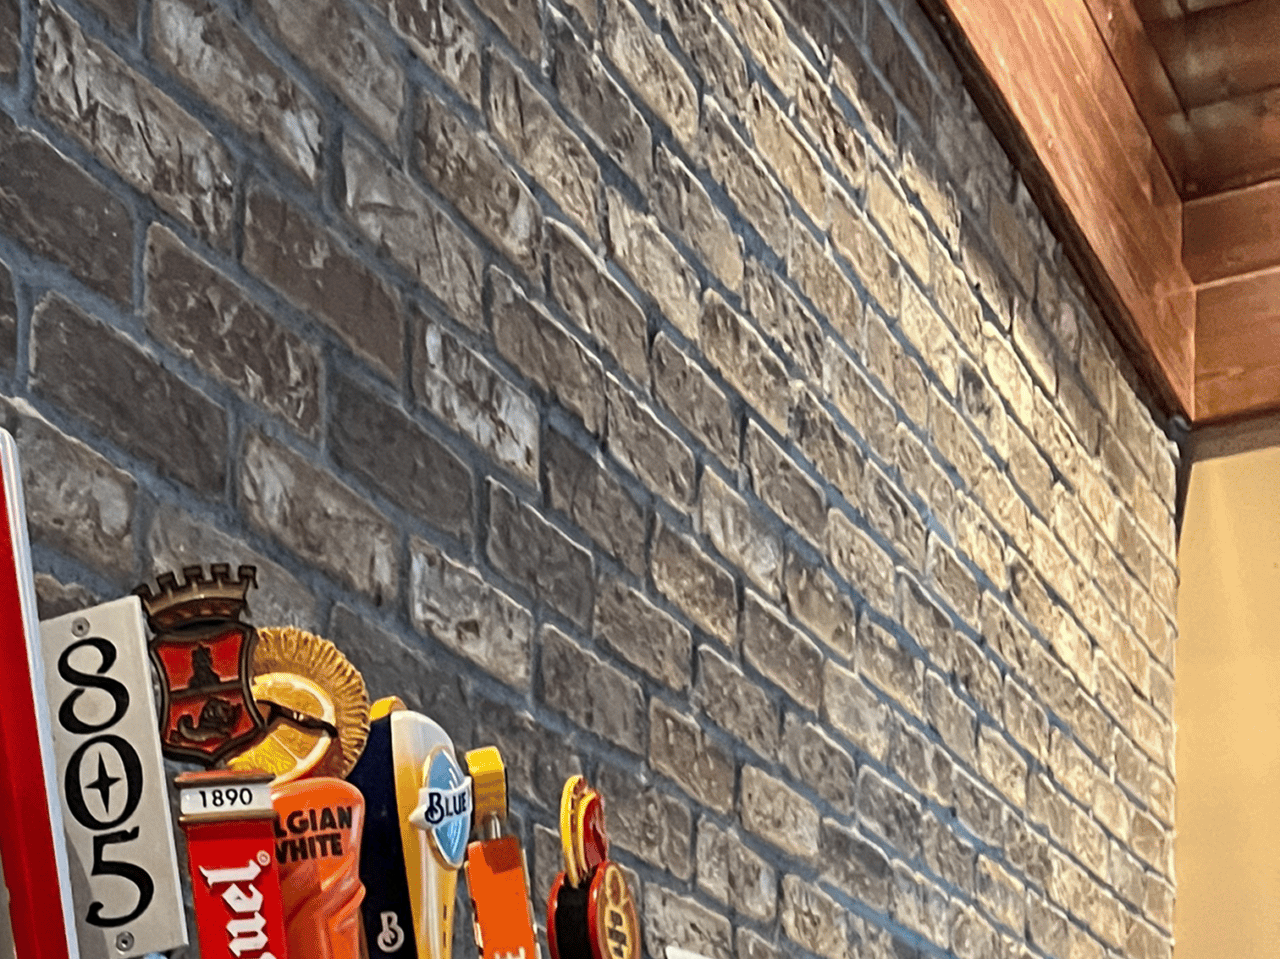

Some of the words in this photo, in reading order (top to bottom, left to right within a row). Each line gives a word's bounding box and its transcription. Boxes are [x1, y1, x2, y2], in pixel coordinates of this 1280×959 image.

[58, 636, 155, 928] 805
[198, 788, 253, 808] 1890
[274, 806, 353, 838] LGIAN
[425, 792, 466, 824] BLUE
